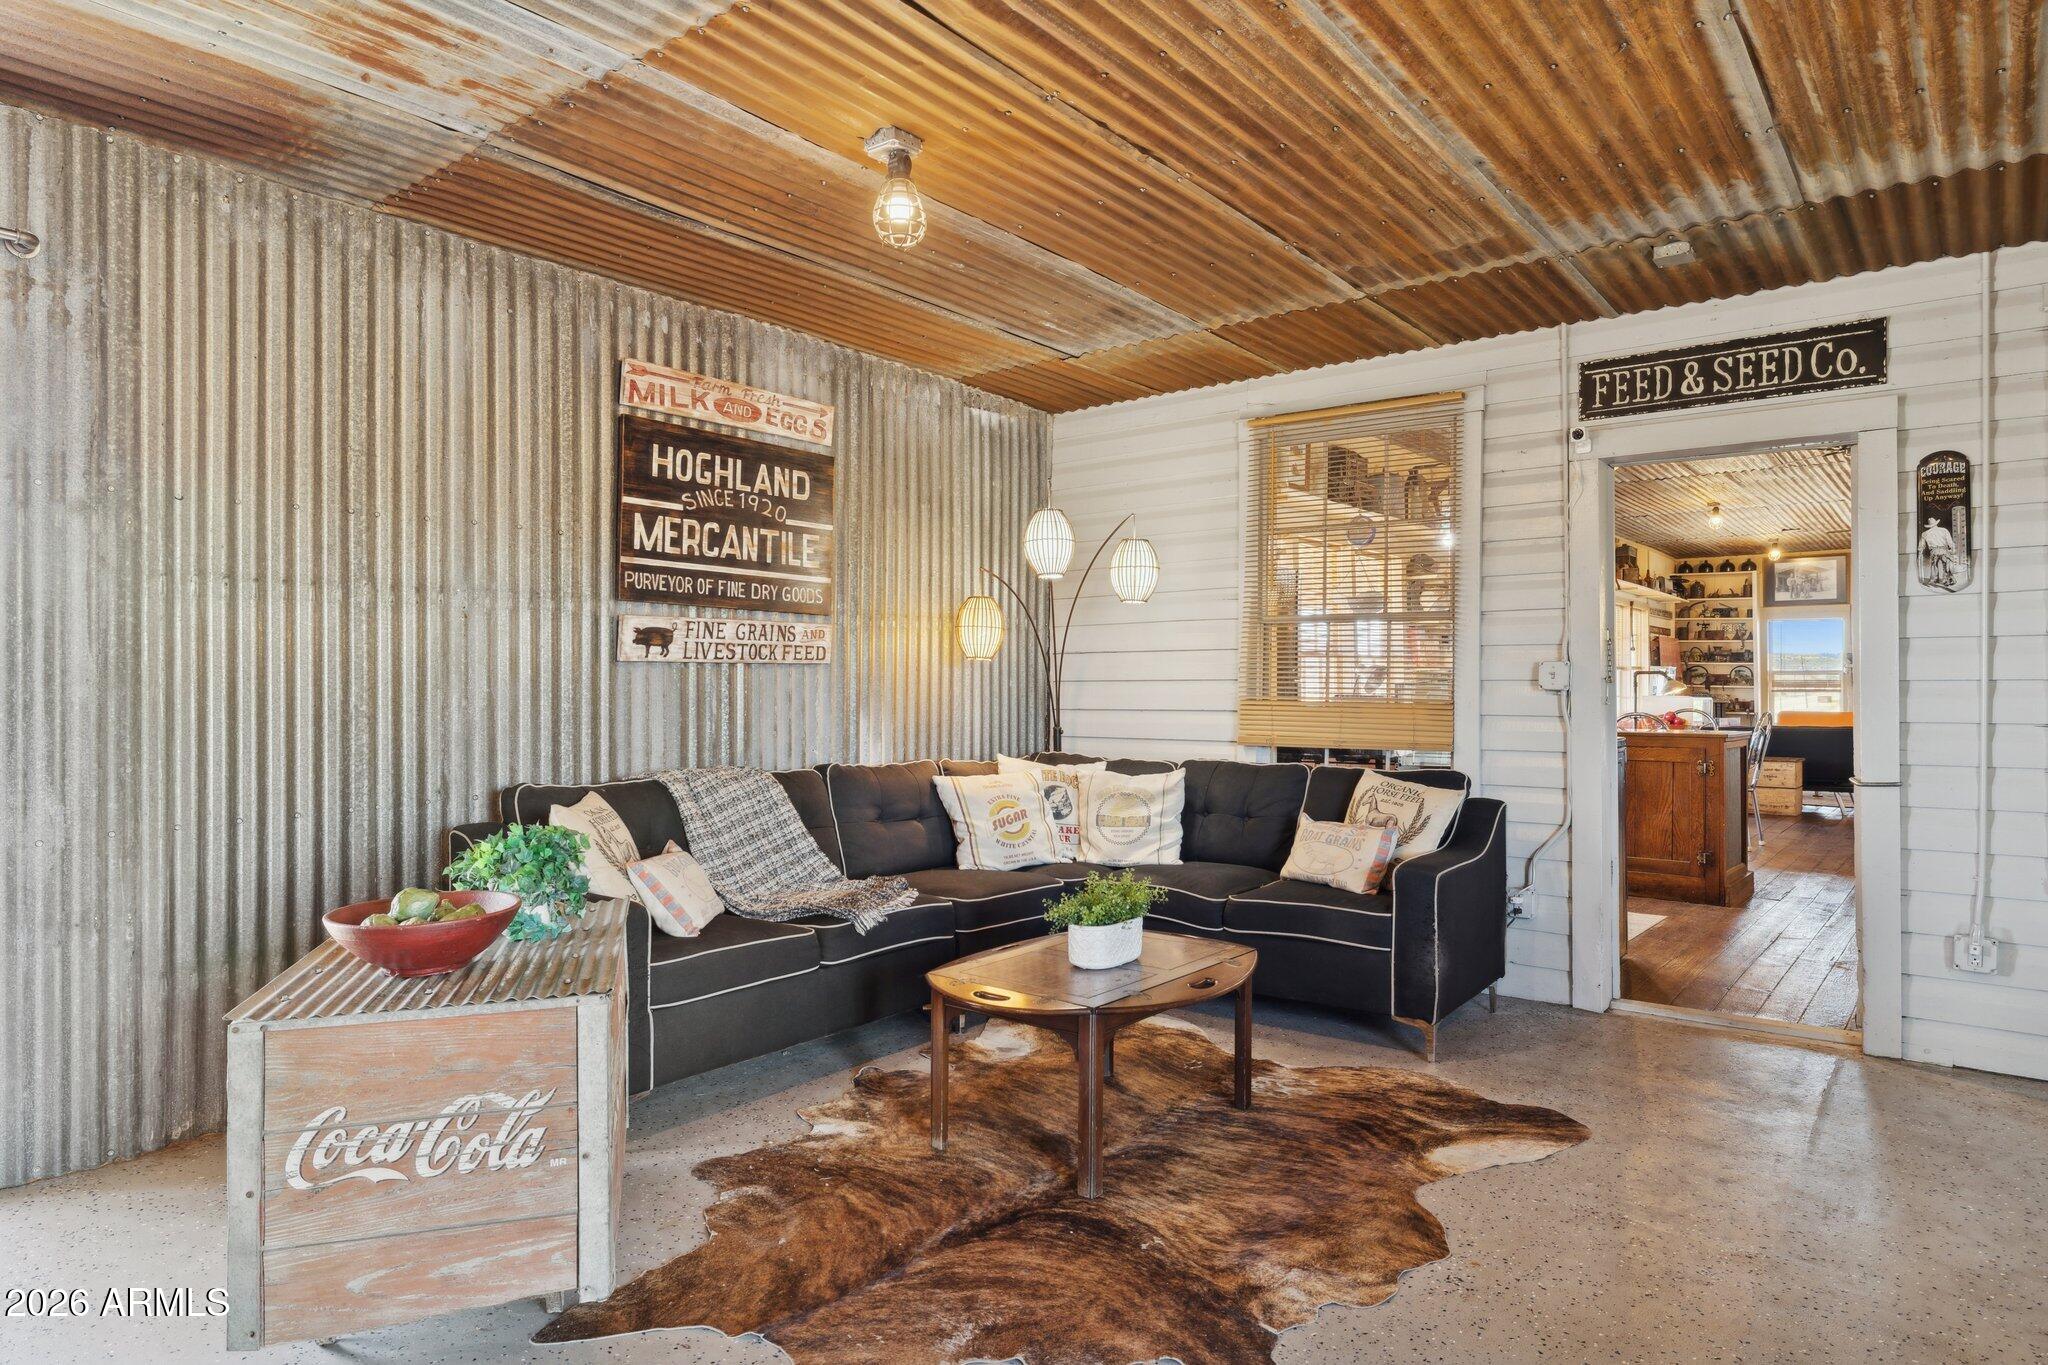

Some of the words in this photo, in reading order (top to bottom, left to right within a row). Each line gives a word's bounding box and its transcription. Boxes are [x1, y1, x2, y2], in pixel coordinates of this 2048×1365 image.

[1592, 364, 1672, 408] FEED
[1681, 361, 1704, 395] &
[1713, 346, 1802, 392] SEED
[1811, 341, 1866, 379] Co.
[692, 376, 732, 396] Farm
[742, 388, 782, 408] Fresh
[628, 379, 710, 411] MILK
[723, 401, 752, 418] AND
[765, 409, 827, 441] EGGS
[651, 443, 811, 501] HOGHLAND
[1920, 461, 1966, 477] COURAGE
[682, 489, 734, 511] SINCE
[739, 493, 787, 523] 1920
[633, 512, 821, 569] MERCANTILE
[624, 571, 693, 594] PURVEYOR
[697, 578, 713, 595] OF
[718, 579, 746, 598] FINE
[751, 583, 779, 601] DRY
[782, 586, 824, 604] GOODS
[685, 621, 727, 640] FINE
[735, 623, 797, 643] GRAINS
[800, 629, 825, 640] AND
[682, 641, 780, 660] LIVESTOCK
[782, 645, 827, 661] FEED
[992, 808, 1029, 831] SUGAR
